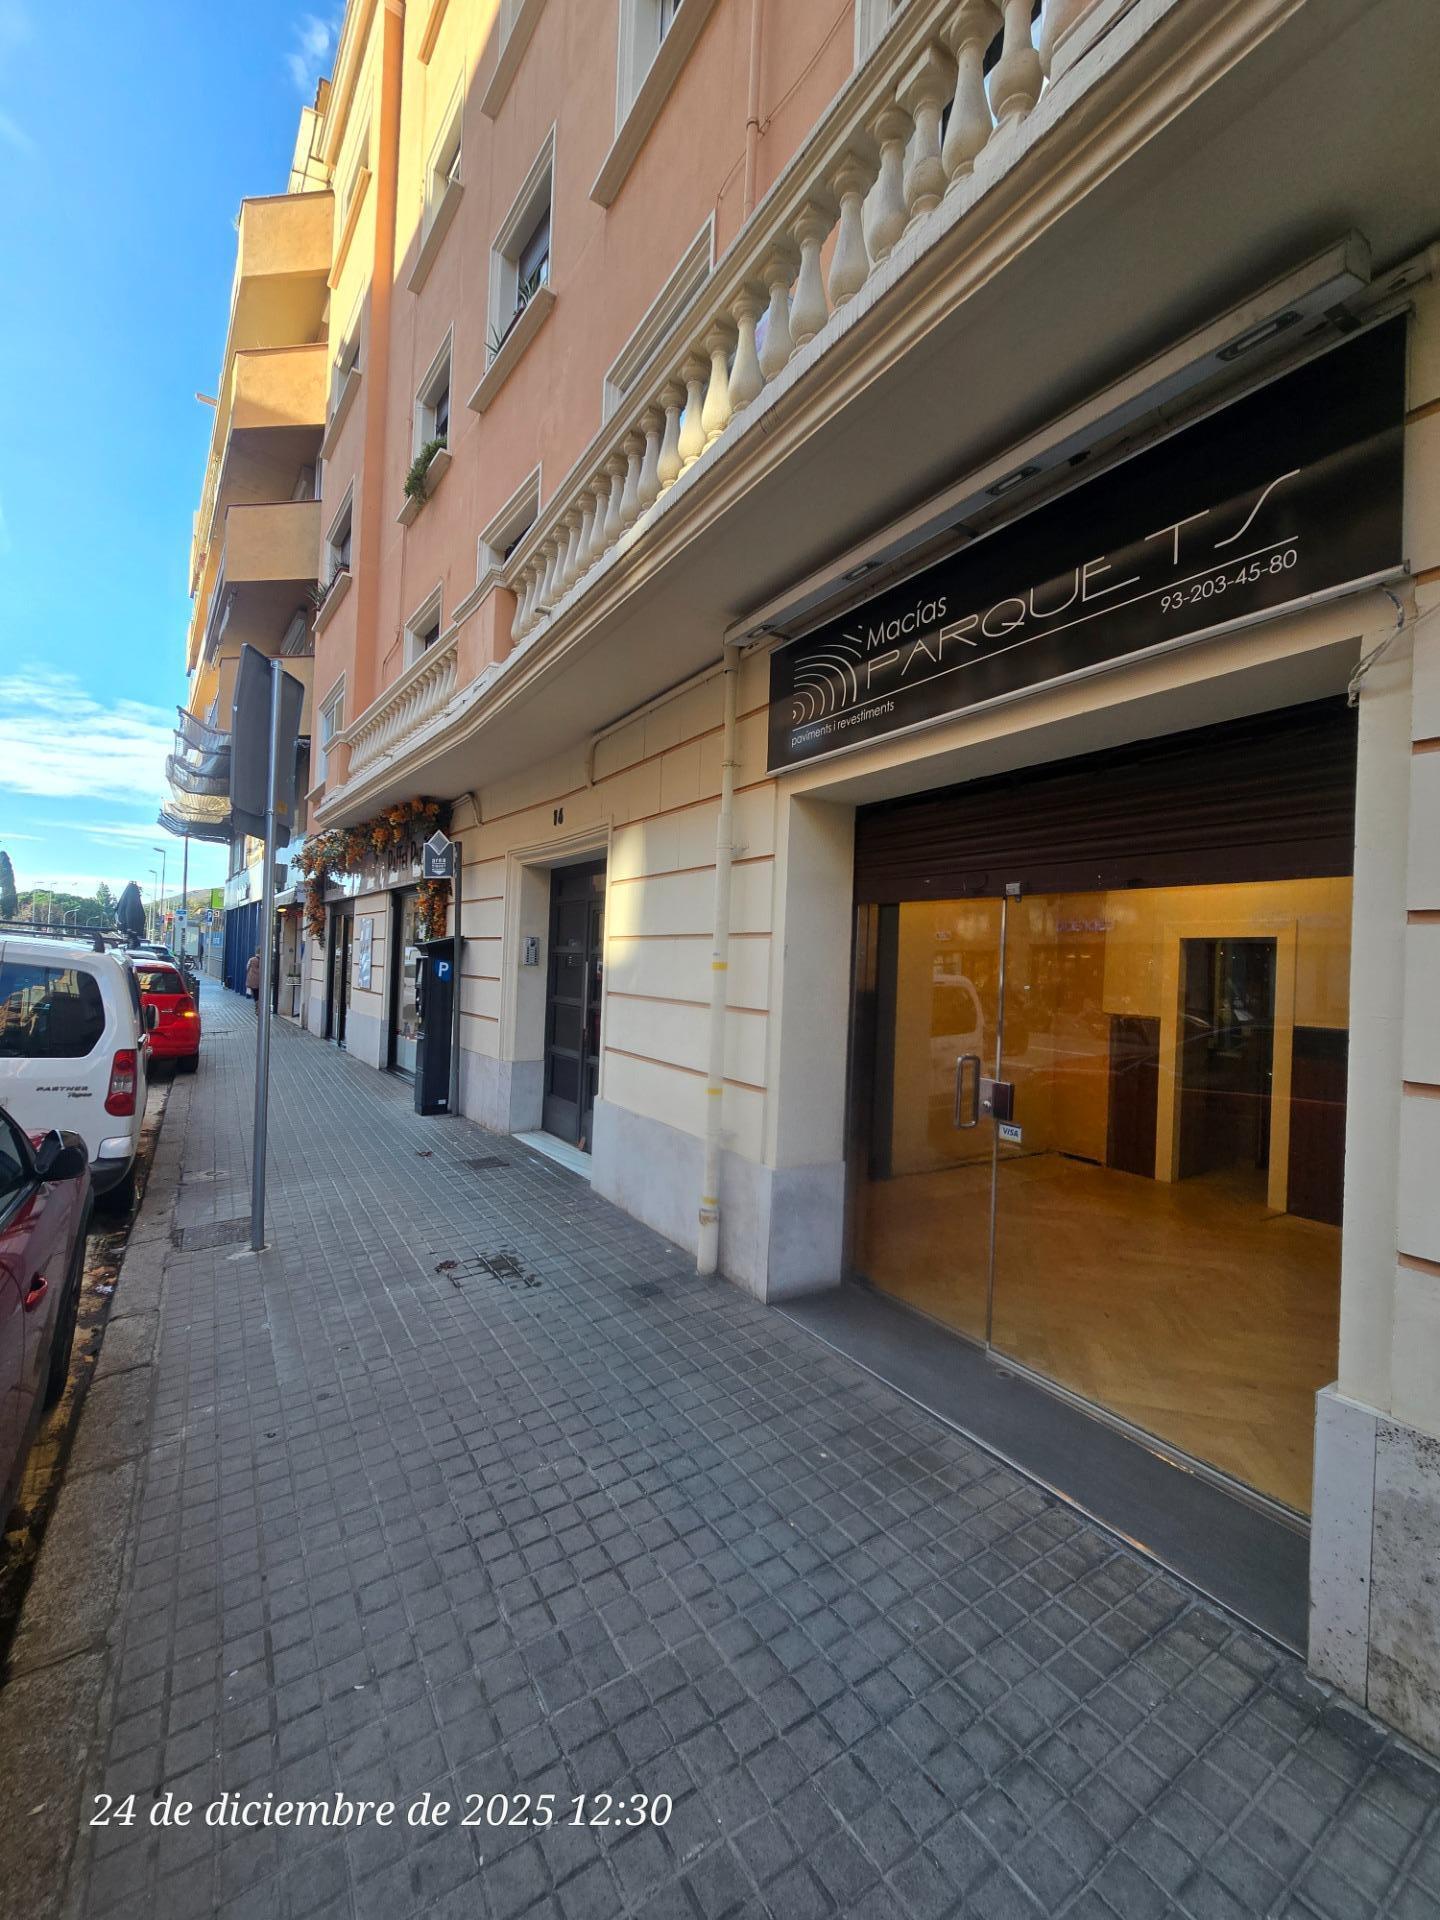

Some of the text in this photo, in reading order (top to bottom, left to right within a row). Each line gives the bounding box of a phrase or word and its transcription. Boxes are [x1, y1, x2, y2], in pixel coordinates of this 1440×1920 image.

[1160, 549, 1297, 613] 93-203-45-80
[867, 596, 947, 650] Macías
[791, 723, 832, 748] paviments
[837, 700, 895, 731] revestiments
[438, 961, 449, 977] P
[1002, 1127, 1019, 1137] VISA
